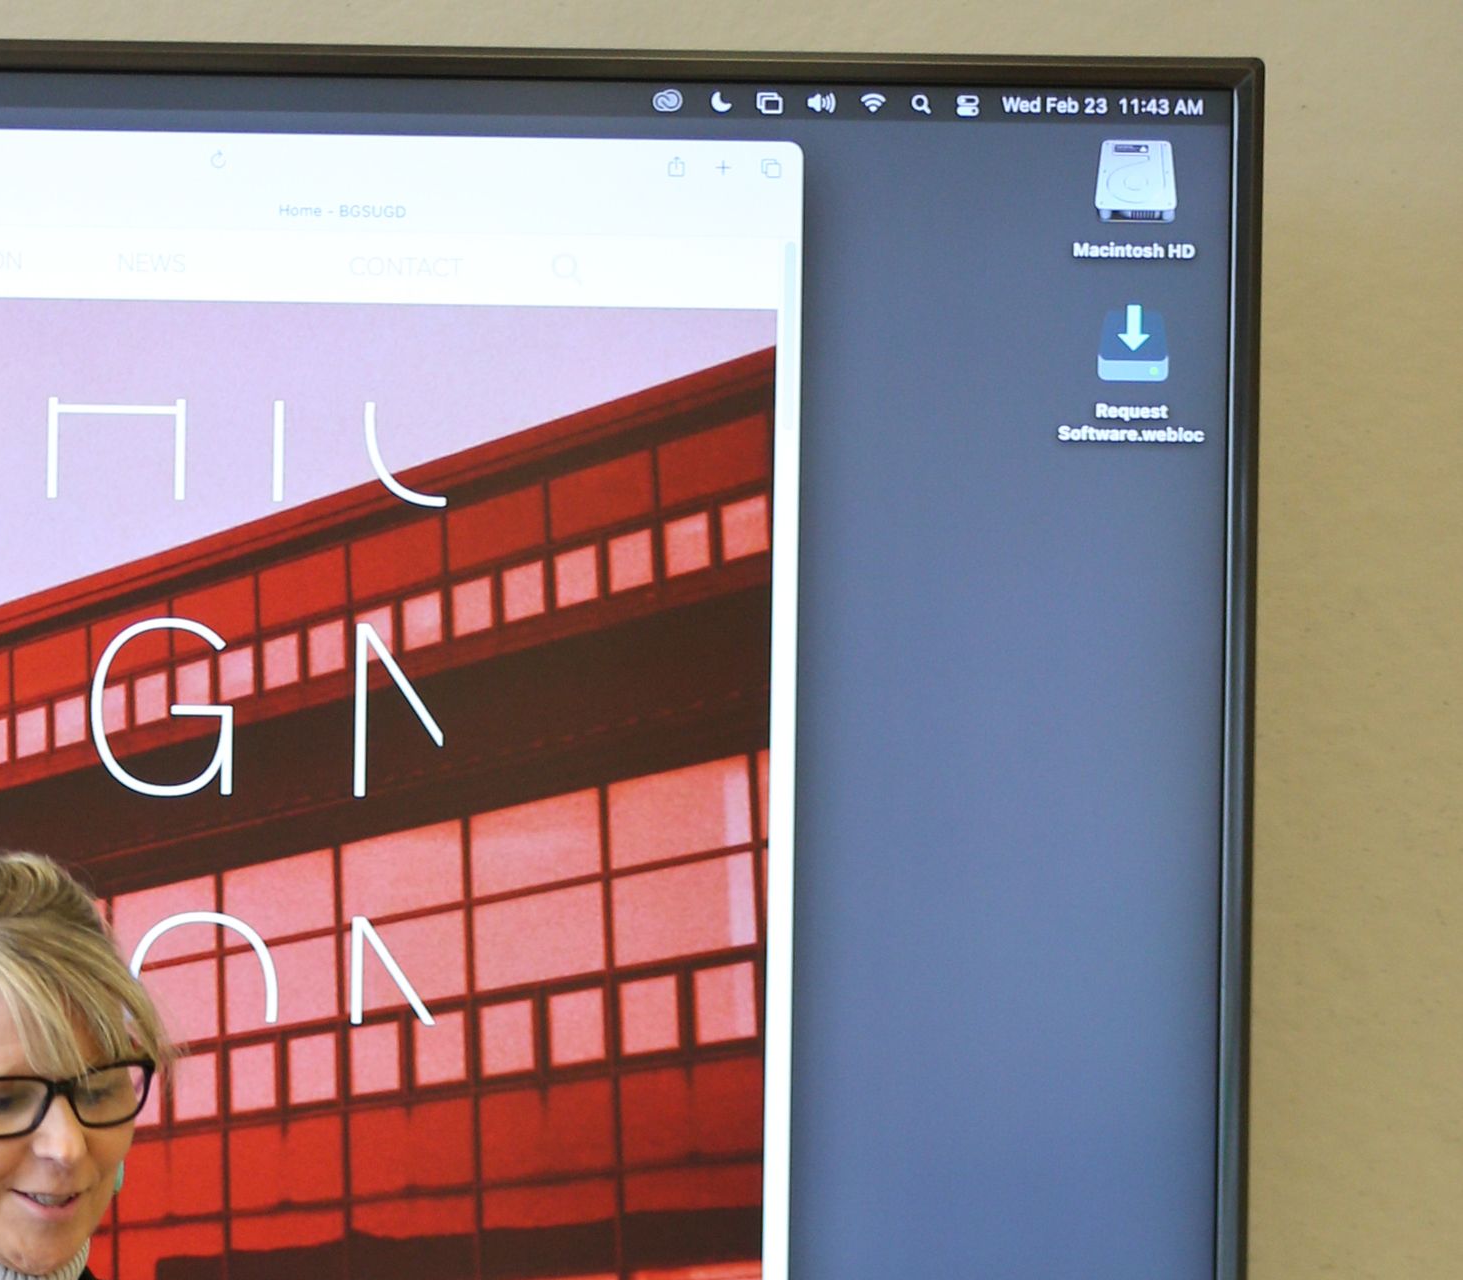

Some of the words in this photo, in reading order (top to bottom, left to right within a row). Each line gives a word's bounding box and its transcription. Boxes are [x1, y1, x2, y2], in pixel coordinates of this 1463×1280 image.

[1001, 95, 1041, 114] Wed
[1046, 96, 1080, 114] Feb
[1084, 97, 1109, 114] 23
[1117, 97, 1169, 116] 11:43
[1174, 98, 1205, 116] AM
[278, 204, 323, 217] Home
[338, 204, 407, 219] BGSUGD
[1073, 240, 1164, 259] Macintosh
[1168, 241, 1196, 260] HD
[117, 251, 186, 273] NEWS
[348, 254, 465, 278] CONTACT
[1095, 403, 1169, 423] Request
[1057, 424, 1205, 443] Software.webloc
